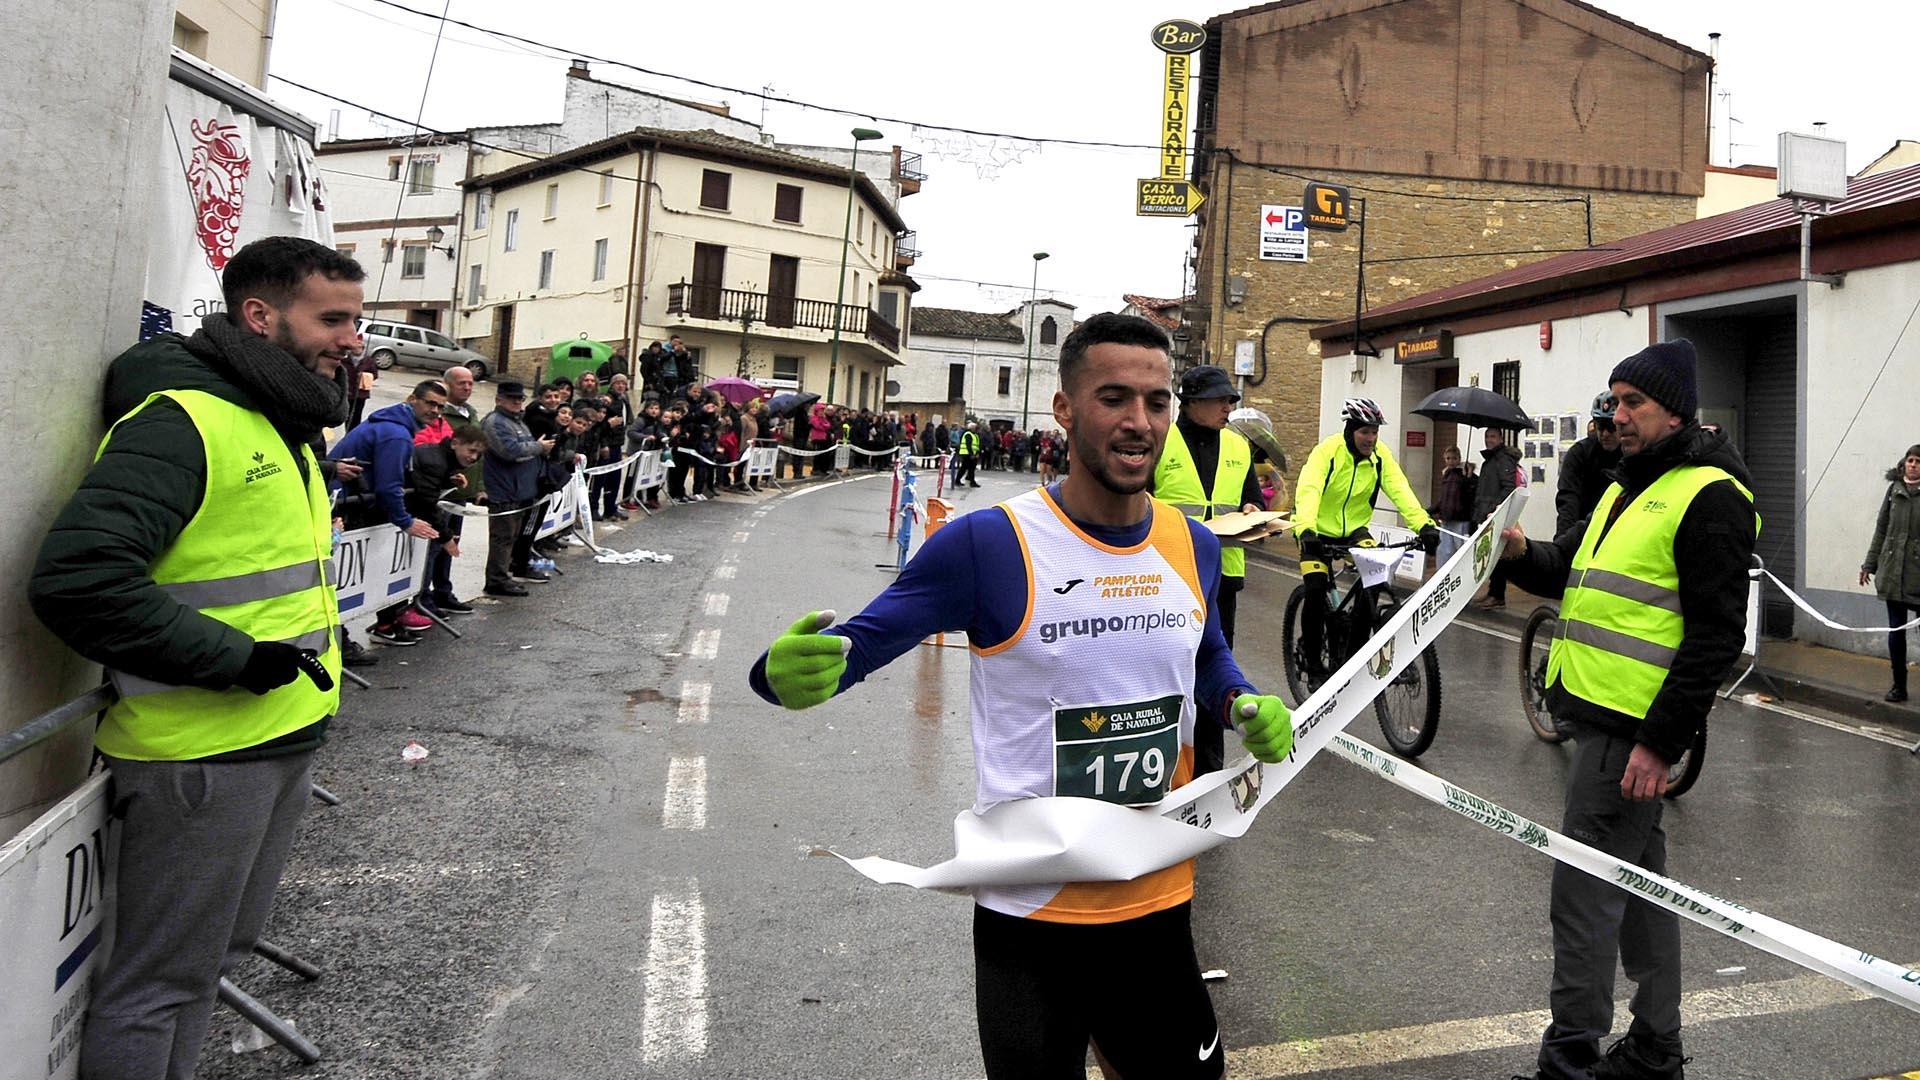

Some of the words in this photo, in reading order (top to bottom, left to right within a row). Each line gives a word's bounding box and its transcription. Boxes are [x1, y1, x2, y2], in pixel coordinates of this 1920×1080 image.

[1158, 25, 1201, 45] Bar
[1165, 56, 1186, 176] RESTAURANTE
[1142, 184, 1175, 194] CASA
[1143, 195, 1185, 206] PERICO
[1287, 211, 1303, 229] P
[1310, 214, 1346, 225] TABACOS
[1407, 339, 1438, 353] TABACOS
[336, 537, 371, 591] DN
[1093, 574, 1163, 587] PAMPLONA
[1420, 603, 1434, 618] DE
[1434, 575, 1462, 607] REYES
[1039, 608, 1186, 644] grupompleo
[1110, 712, 1133, 723] CAJA
[1135, 706, 1163, 719] RURAL
[1111, 722, 1124, 732] DE
[1126, 714, 1166, 730] NAVARRA
[1086, 747, 1165, 796] 179
[1181, 802, 1195, 819] del
[1617, 867, 1669, 899] RURAL
